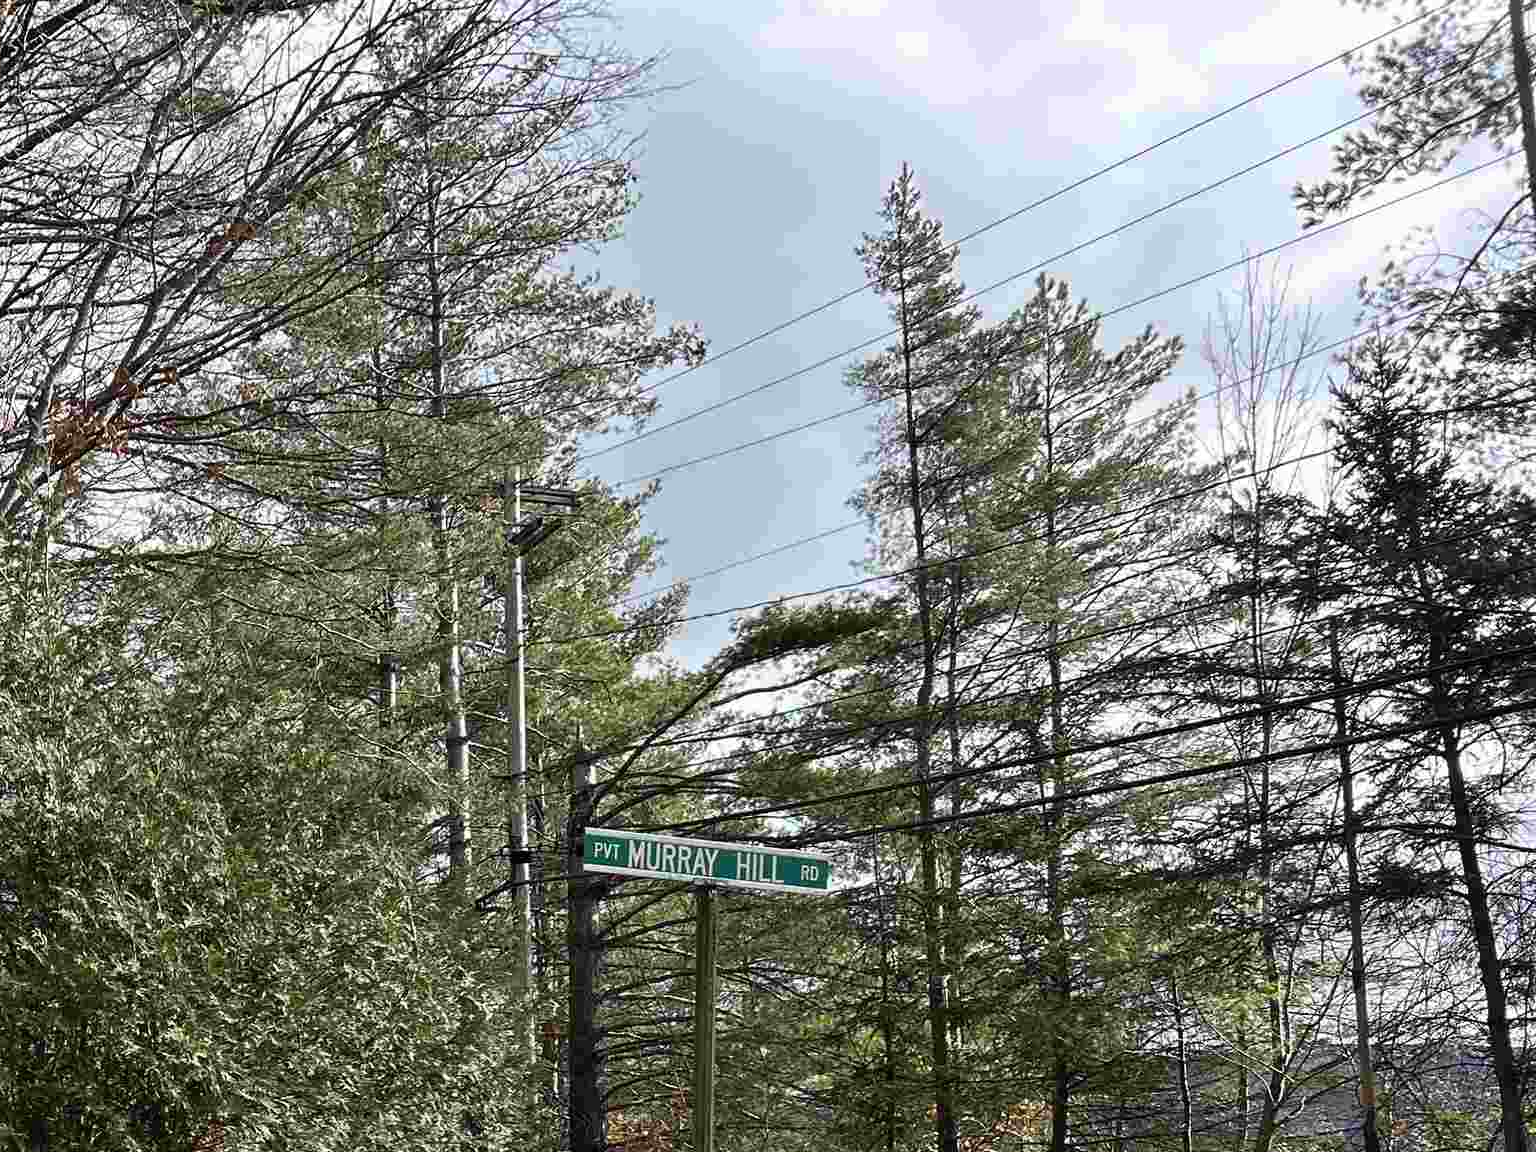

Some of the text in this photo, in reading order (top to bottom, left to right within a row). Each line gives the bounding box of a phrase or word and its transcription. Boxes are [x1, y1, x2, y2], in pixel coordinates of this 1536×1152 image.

[594, 838, 819, 883] PVT MURRAY HILL RD
